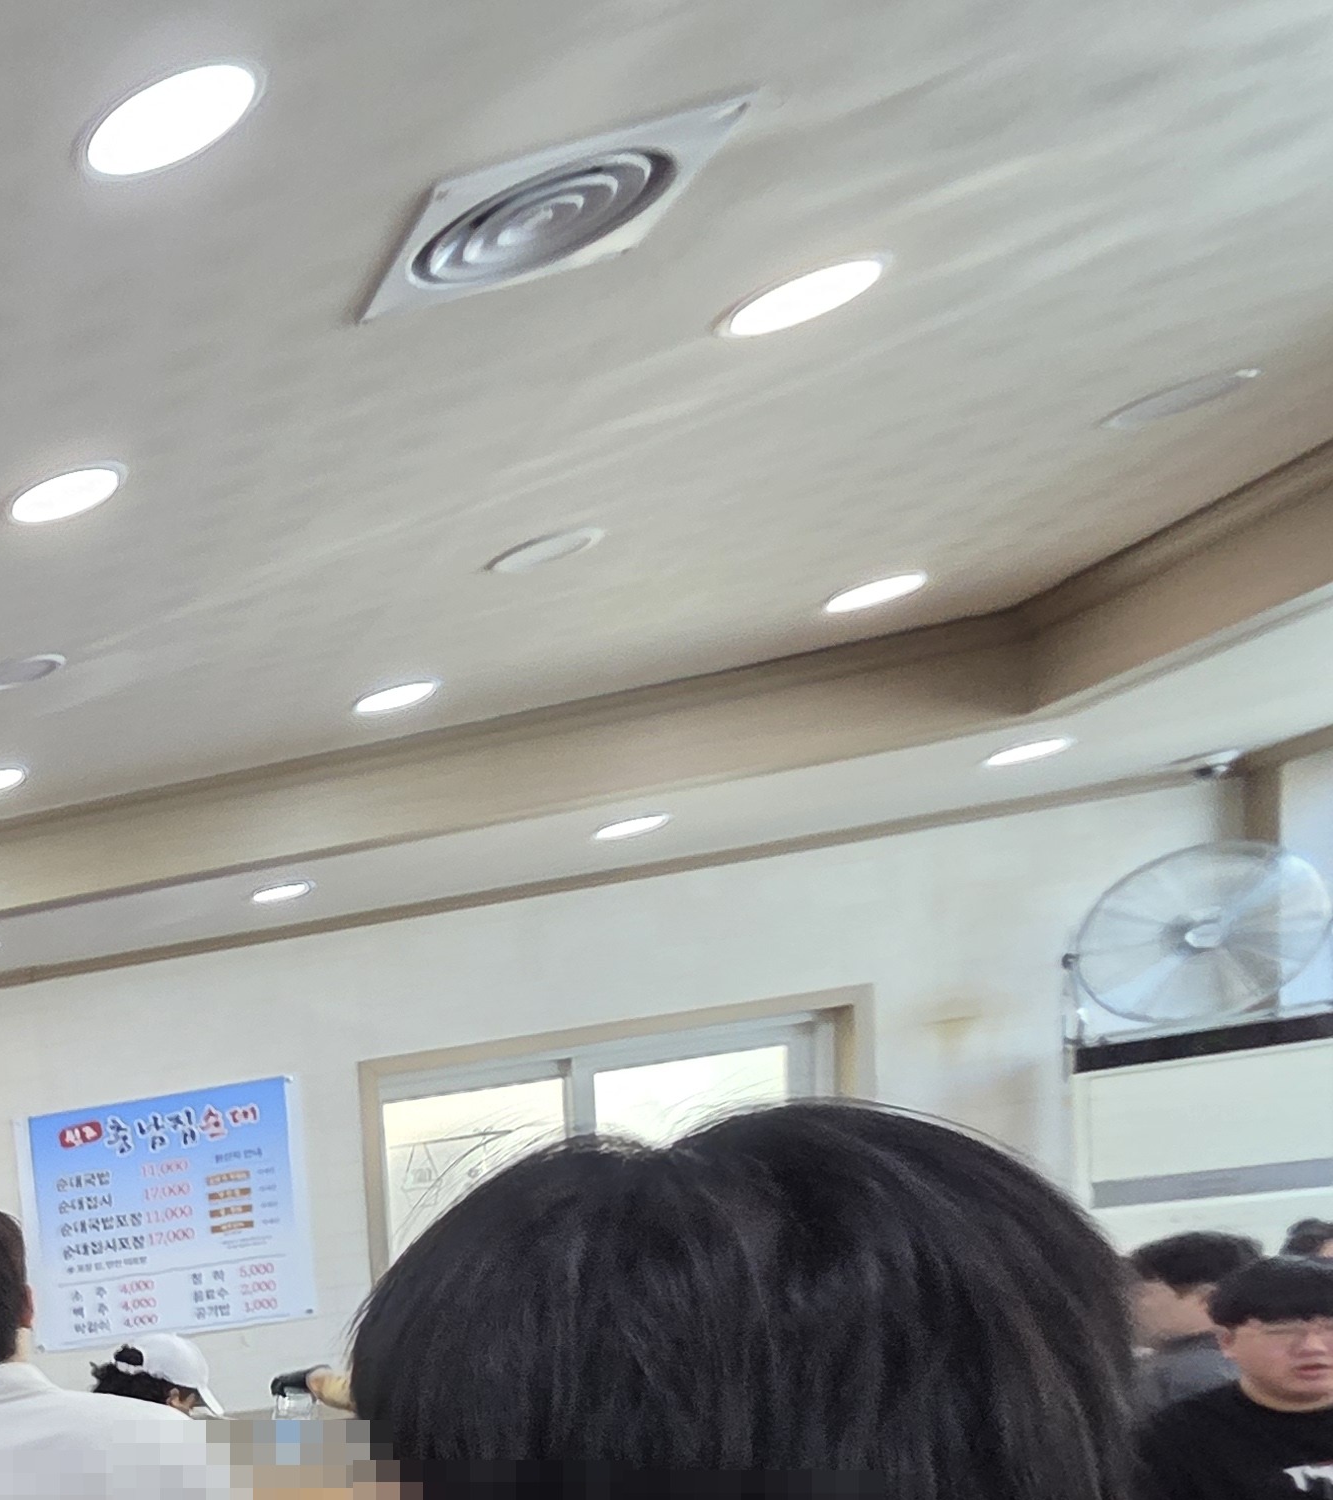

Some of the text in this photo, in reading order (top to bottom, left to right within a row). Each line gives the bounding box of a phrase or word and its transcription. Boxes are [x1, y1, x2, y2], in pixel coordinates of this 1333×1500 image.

[141, 1160, 189, 1178] 11,000
[144, 1181, 191, 1201] 17,000
[146, 1204, 193, 1224] 11,000
[148, 1227, 195, 1247] 17,000
